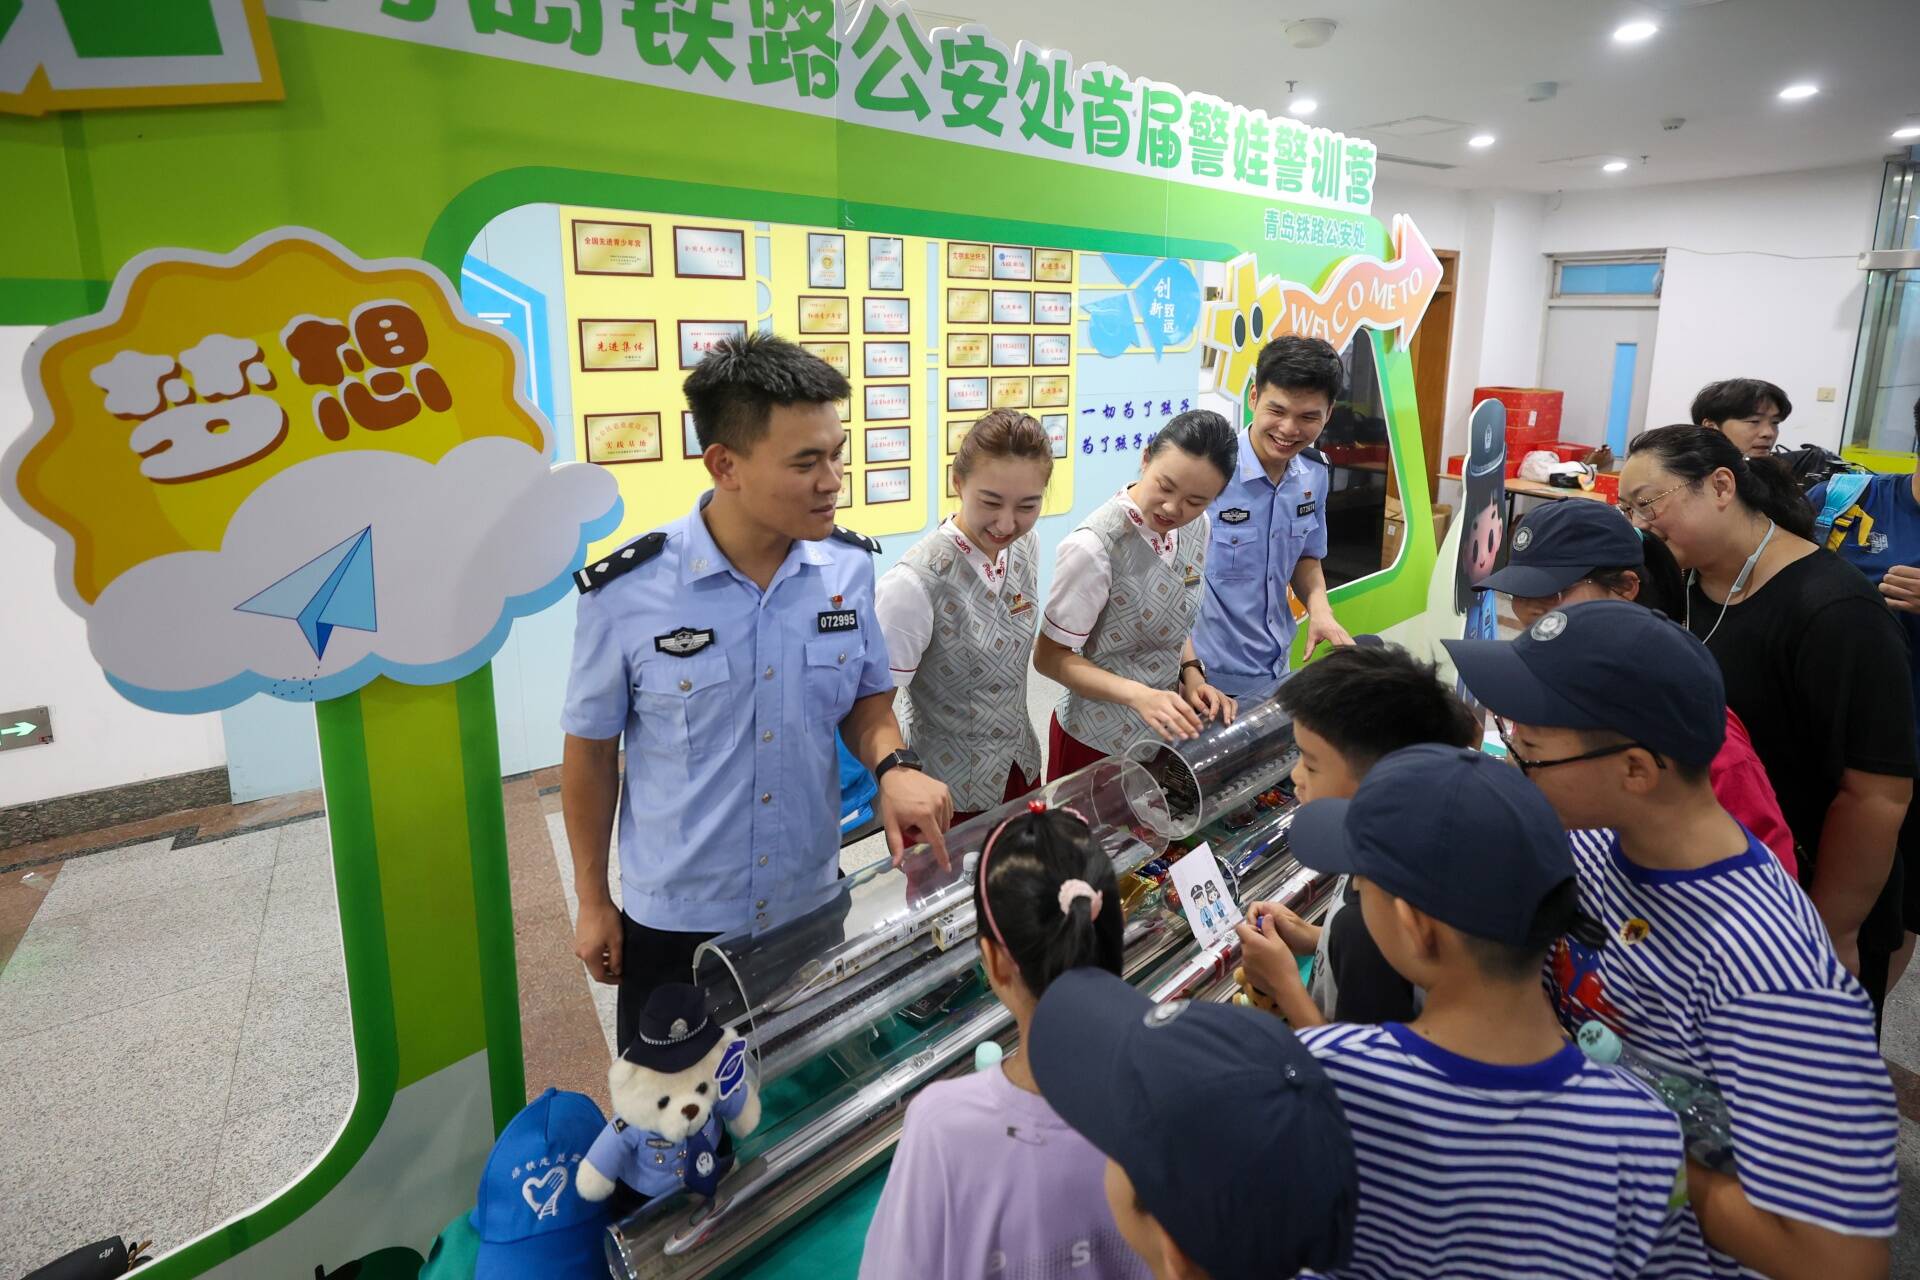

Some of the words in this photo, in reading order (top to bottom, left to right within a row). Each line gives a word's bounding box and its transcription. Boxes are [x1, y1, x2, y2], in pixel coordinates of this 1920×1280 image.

[1264, 208, 1367, 250] 青岛铁路公安处
[597, 341, 645, 352] 先进集体
[90, 299, 454, 485] 梦想
[1082, 398, 1190, 421] 一切为了孩子
[820, 613, 856, 629] 072995
